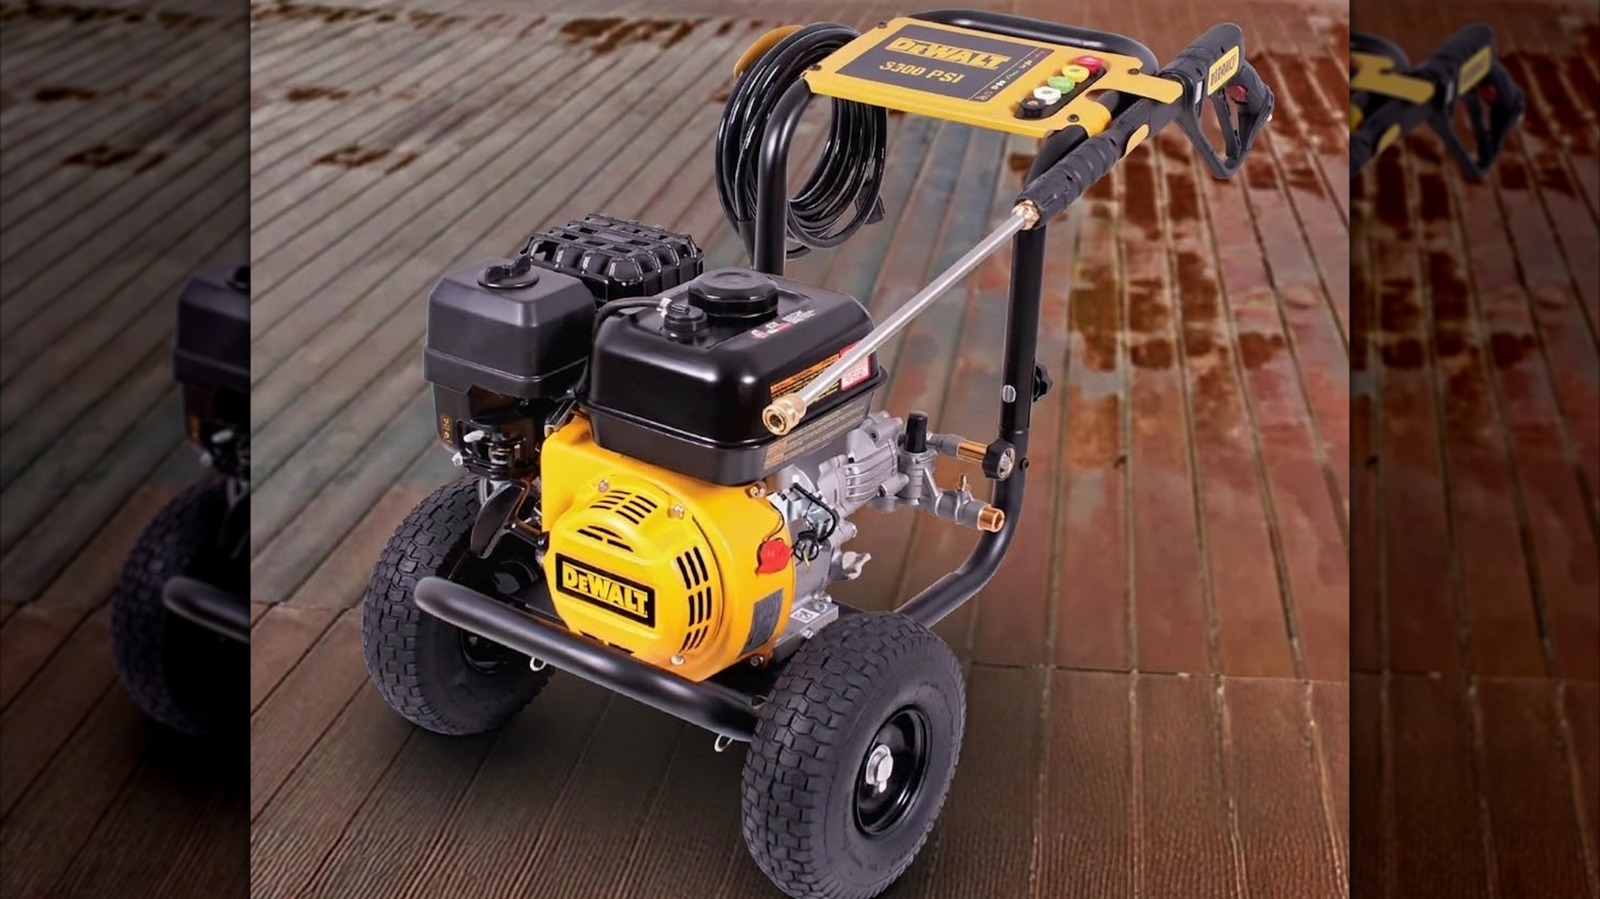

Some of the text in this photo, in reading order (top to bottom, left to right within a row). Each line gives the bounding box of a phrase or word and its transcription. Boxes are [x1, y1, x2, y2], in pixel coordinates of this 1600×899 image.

[885, 36, 1012, 70] DEWALT
[926, 69, 966, 84] PSI
[562, 561, 648, 618] DEWALT
